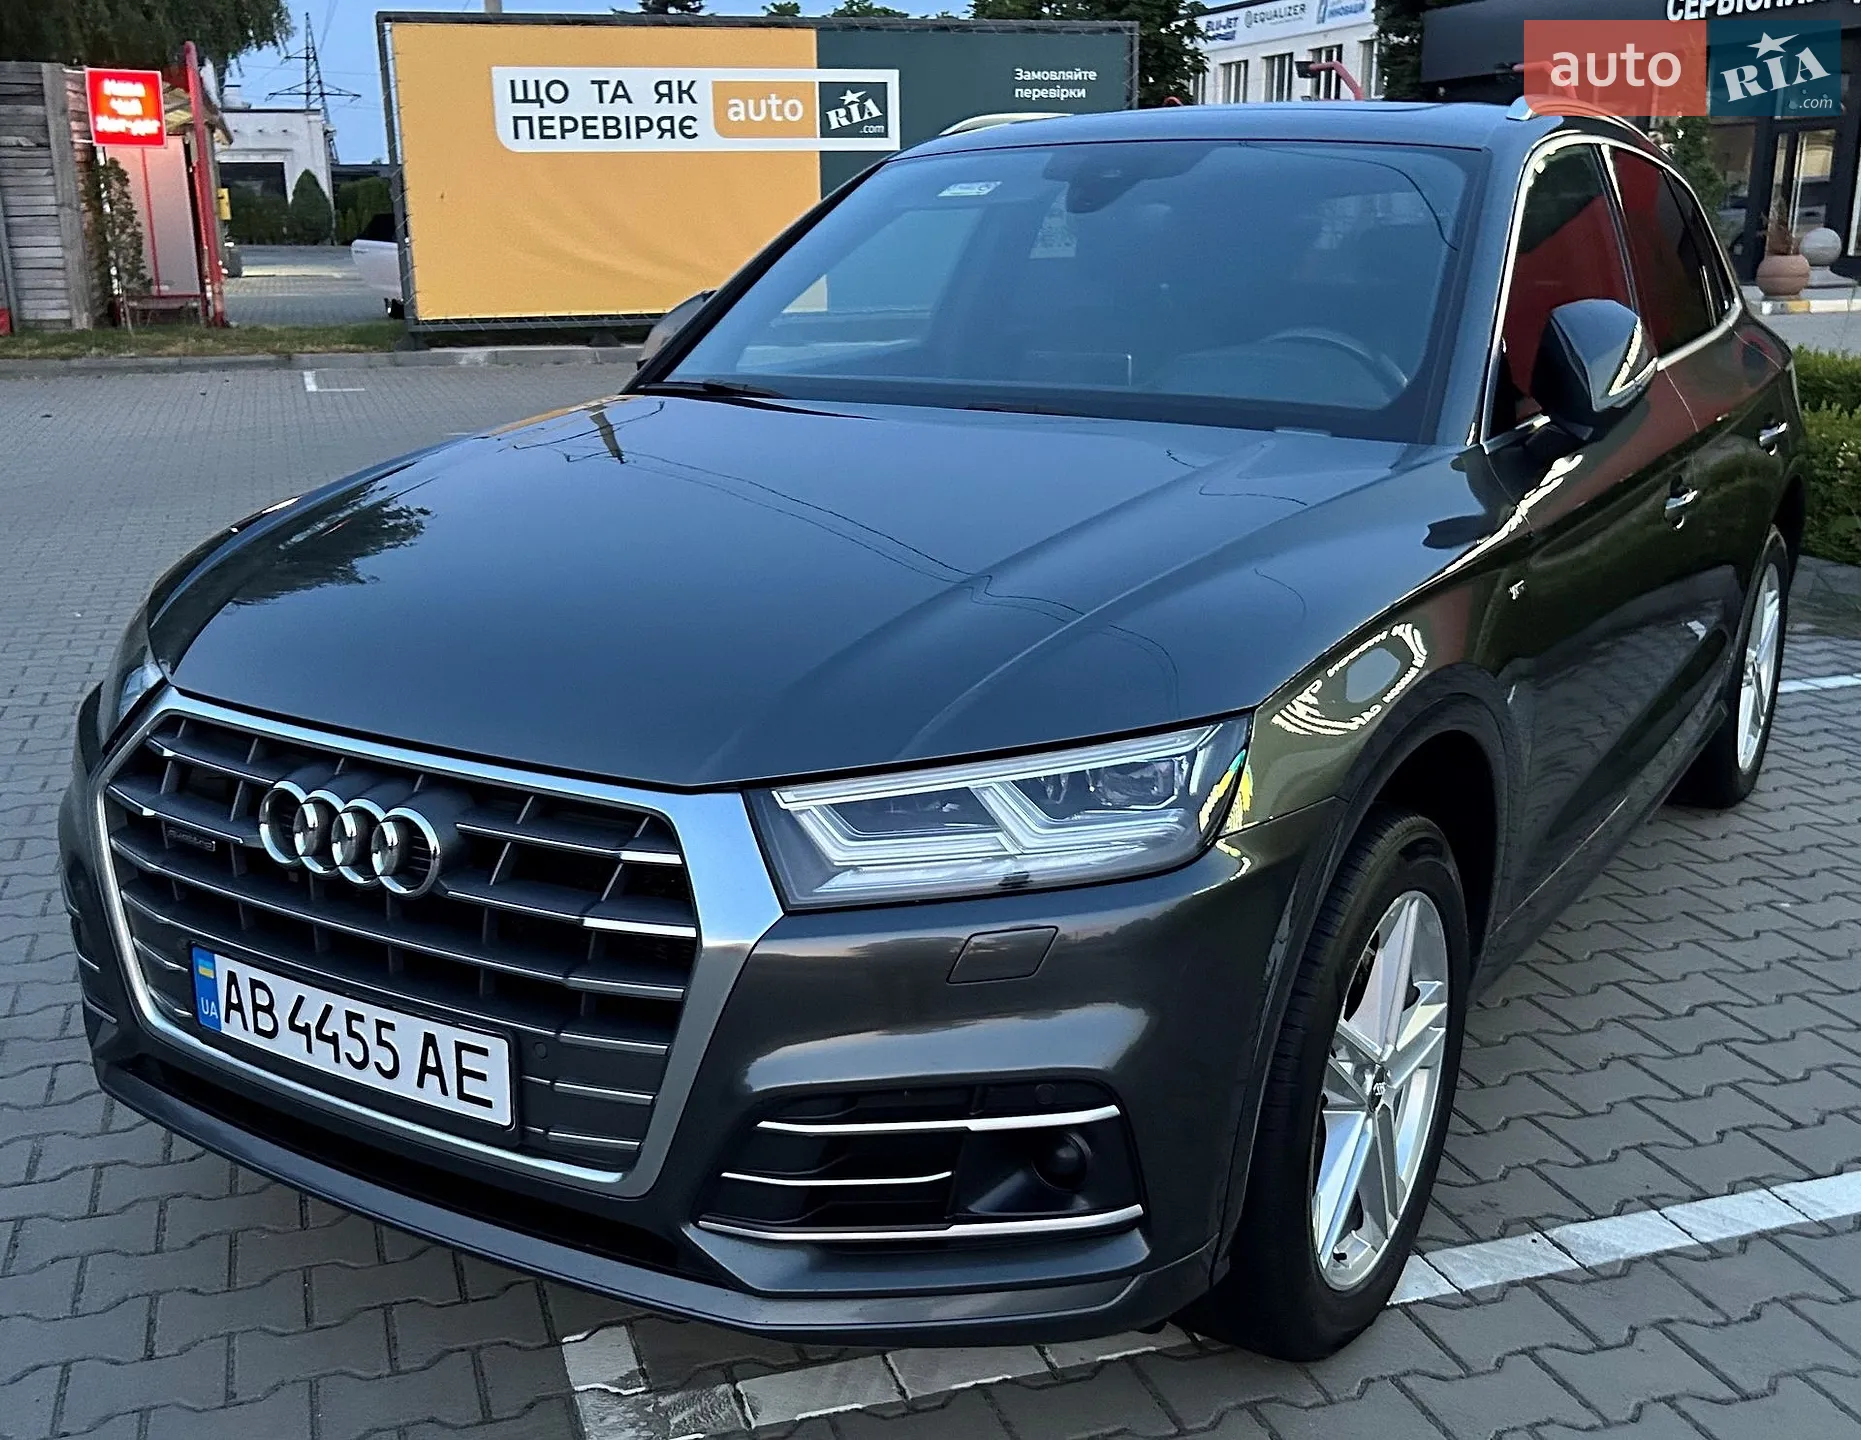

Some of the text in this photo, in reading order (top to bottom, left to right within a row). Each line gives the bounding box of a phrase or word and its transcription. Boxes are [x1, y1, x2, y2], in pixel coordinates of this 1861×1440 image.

[1253, 3, 1306, 24] EQUALIZER
[1014, 68, 1098, 81] Замовляйте
[509, 79, 699, 107] ЩО ТА ЯК
[1014, 85, 1087, 101] перевірки
[727, 93, 885, 134] auto RIA .com
[512, 115, 699, 140] ПЕРЕВІРЯЄ
[201, 997, 219, 1020] UA
[224, 970, 494, 1110] AB 4455 AE
